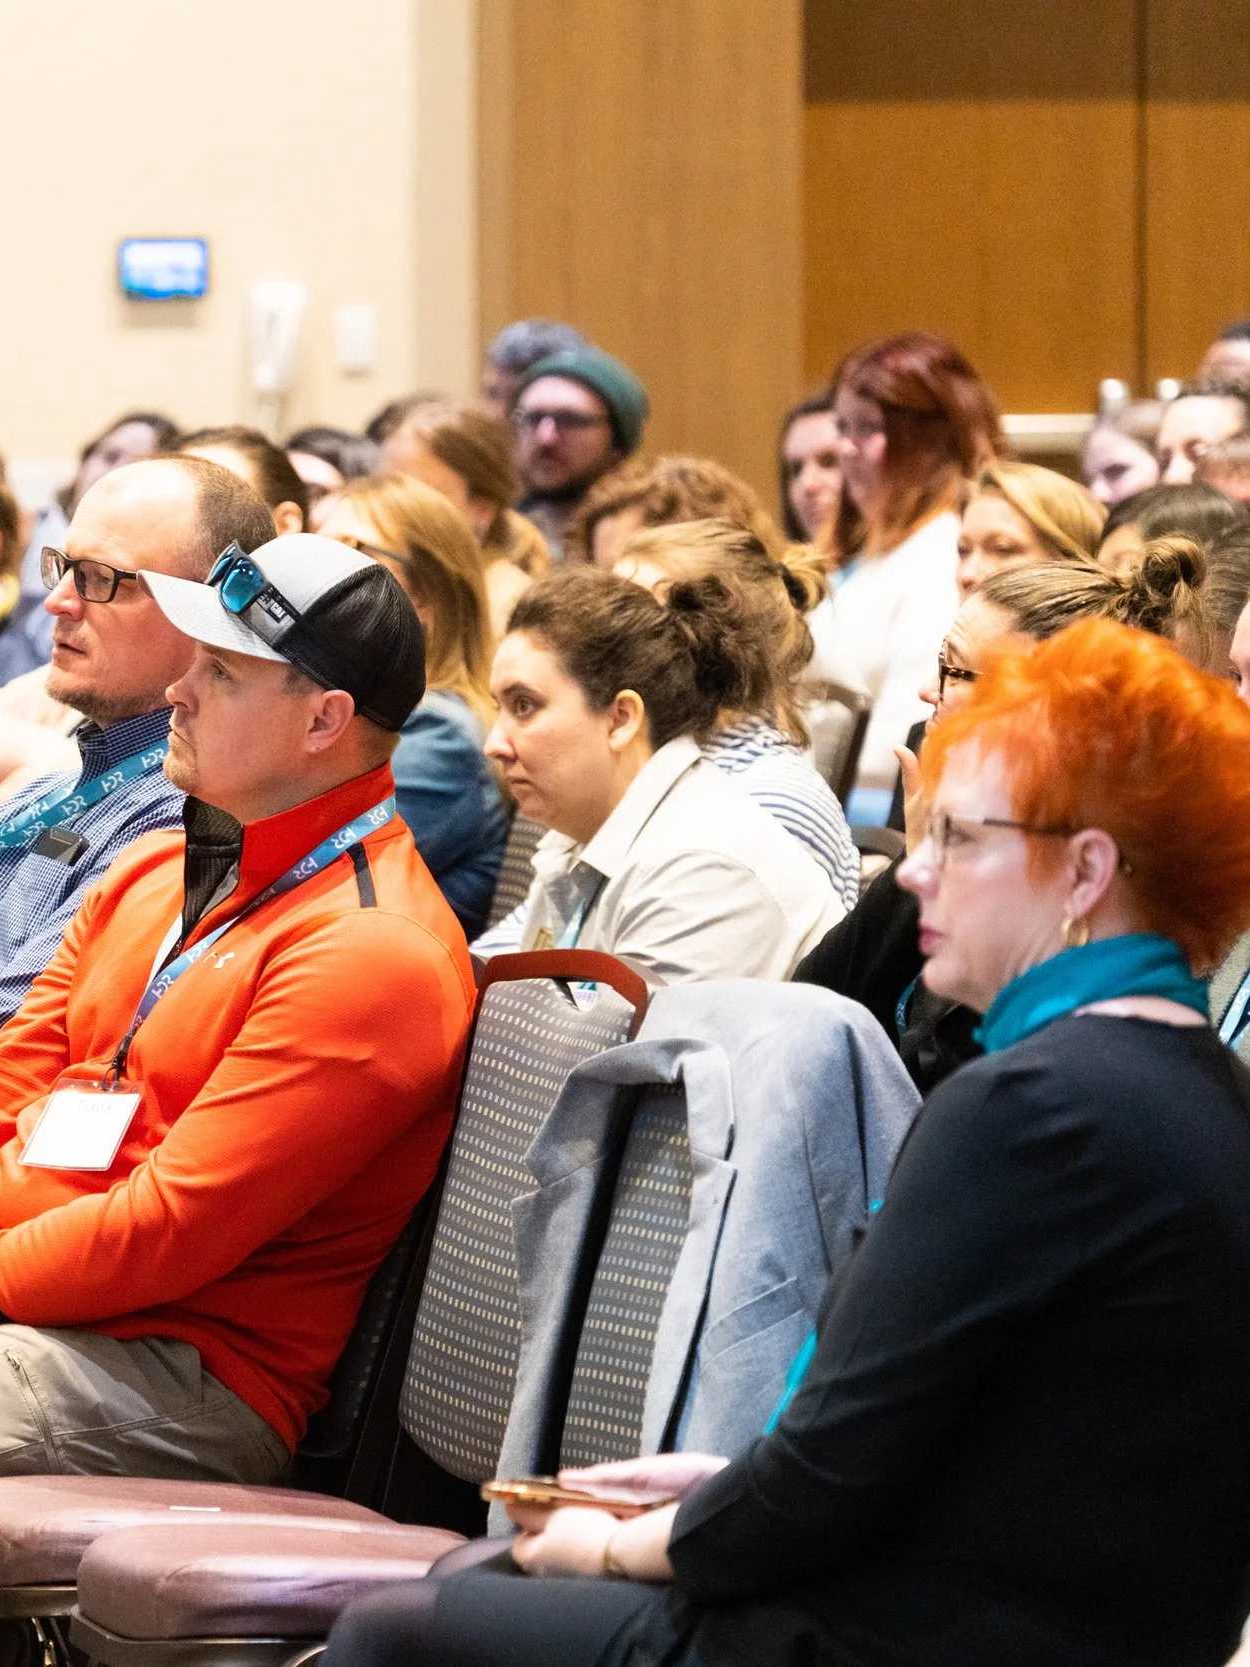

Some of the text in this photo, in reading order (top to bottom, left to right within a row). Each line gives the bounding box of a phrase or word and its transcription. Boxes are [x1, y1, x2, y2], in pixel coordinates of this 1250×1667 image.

[270, 602, 287, 618] CAT
[141, 748, 167, 769] HDR
[101, 771, 125, 793] HDR
[61, 795, 88, 816] HDR
[367, 806, 389, 825] HDR
[23, 820, 48, 837] HDR
[330, 826, 358, 849] HDR
[292, 856, 319, 880] HDR
[151, 974, 175, 999] HDR
